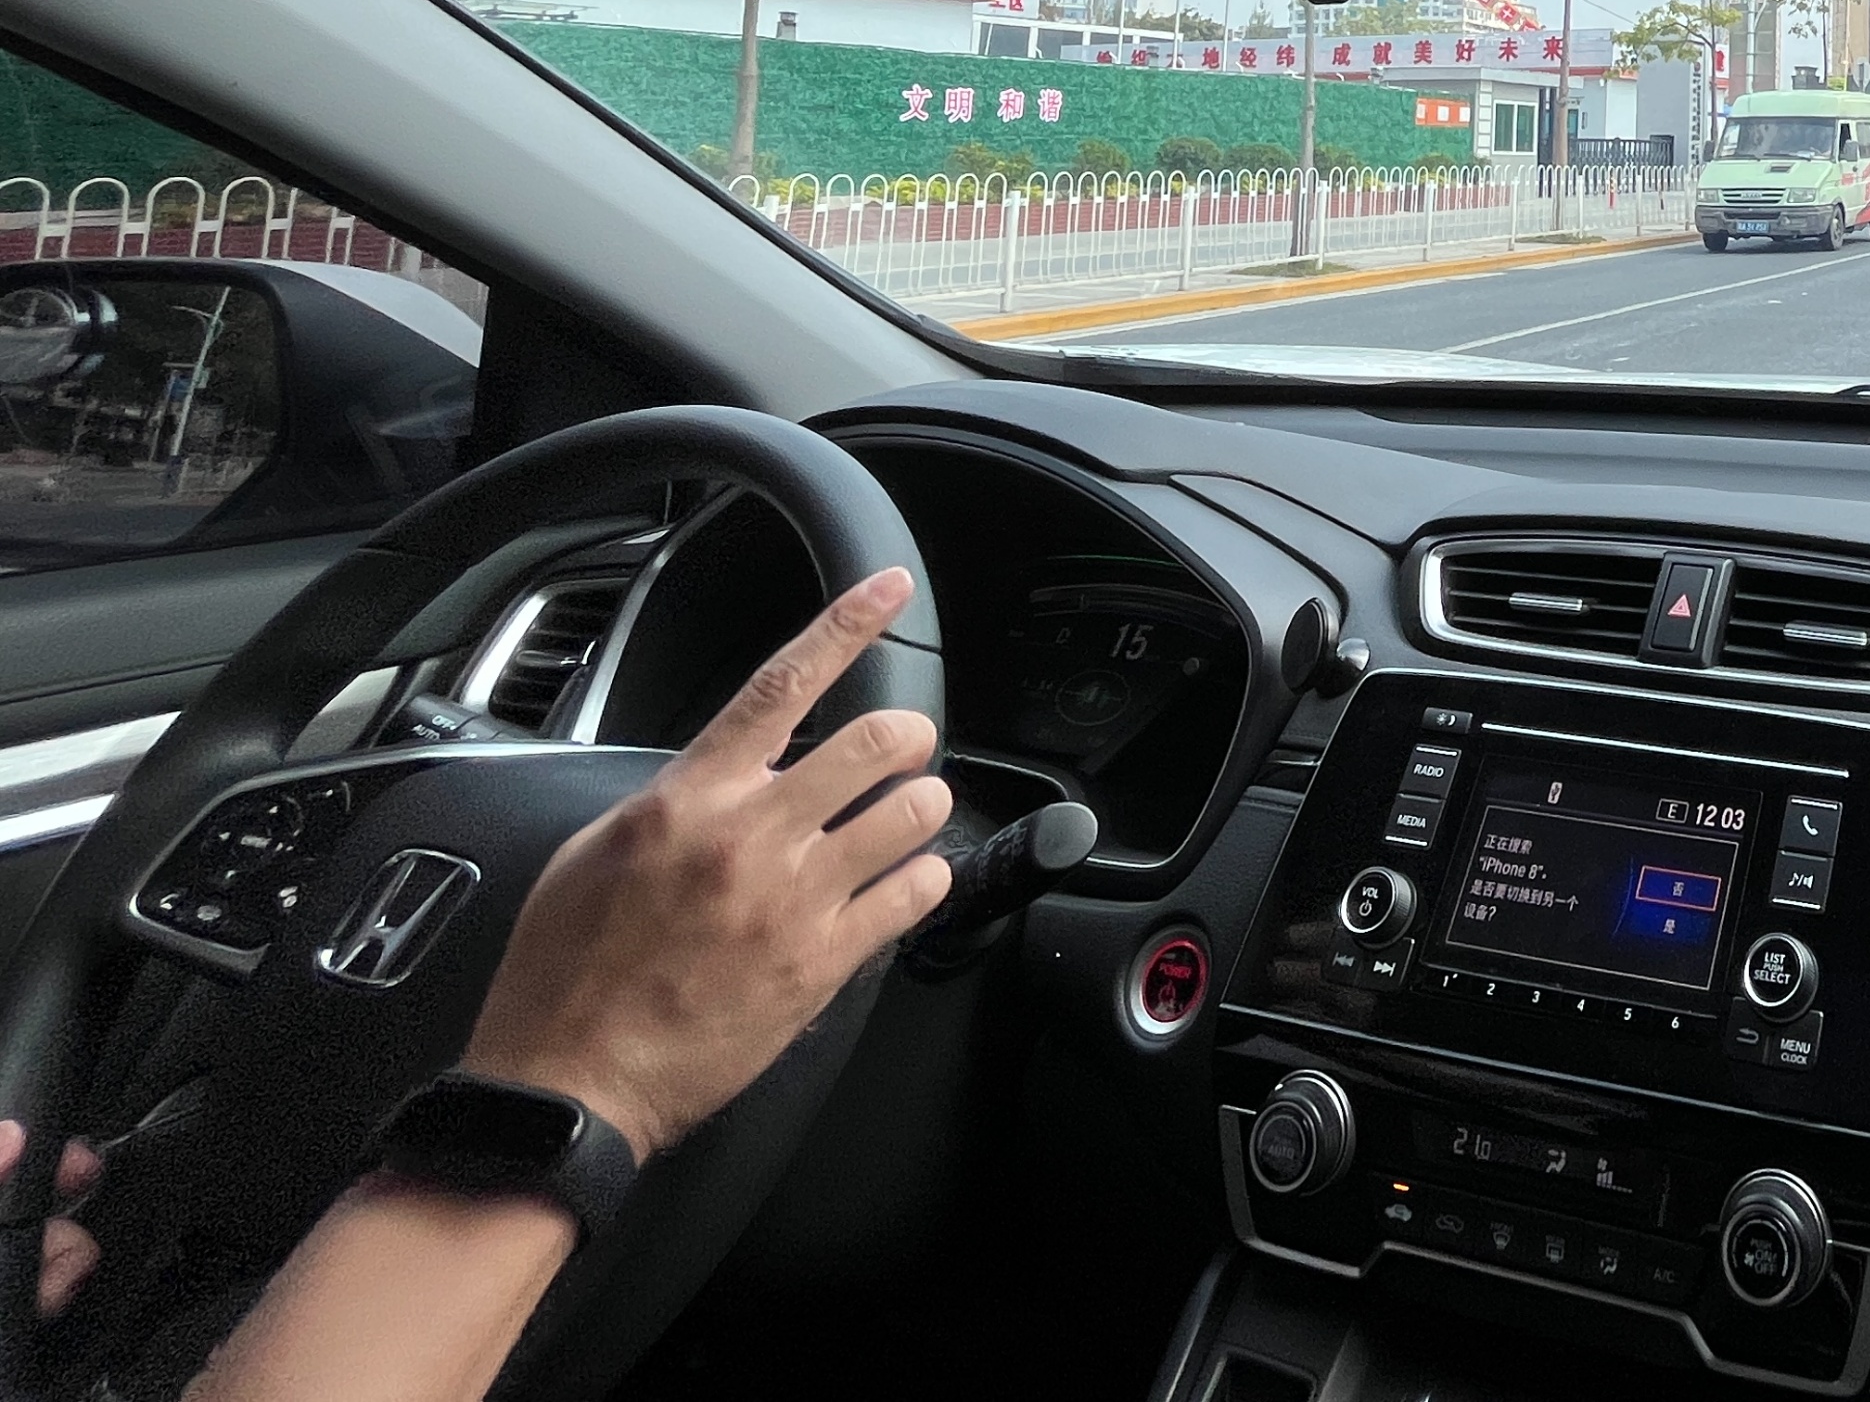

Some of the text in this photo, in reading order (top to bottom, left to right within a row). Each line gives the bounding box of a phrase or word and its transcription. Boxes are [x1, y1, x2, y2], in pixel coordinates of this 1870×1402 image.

[1332, 36, 1563, 66] 成就美好未来
[900, 84, 1062, 122] 文明 和谐
[1109, 622, 1155, 661] 15
[1413, 763, 1445, 778] RADIO
[1667, 803, 1679, 819] E
[1397, 814, 1426, 828] MEDIA
[1484, 833, 1533, 854] 正在搜索
[1362, 886, 1380, 899] VOL
[1469, 878, 1579, 912] 是否要切换到另一个
[1672, 881, 1685, 896] 否
[1663, 918, 1676, 934] 是
[1764, 952, 1786, 964] LIST
[1763, 962, 1783, 972] PUSH
[1753, 969, 1791, 984] SELECT
[1486, 983, 1496, 995] 2
[1532, 991, 1540, 1003] 3
[1577, 999, 1585, 1012] 4
[1623, 1008, 1632, 1020] 5
[1671, 1016, 1679, 1028] 6
[1780, 1038, 1811, 1054] MENU
[1780, 1052, 1807, 1065] CLOCK
[1653, 1267, 1676, 1284] A/C
